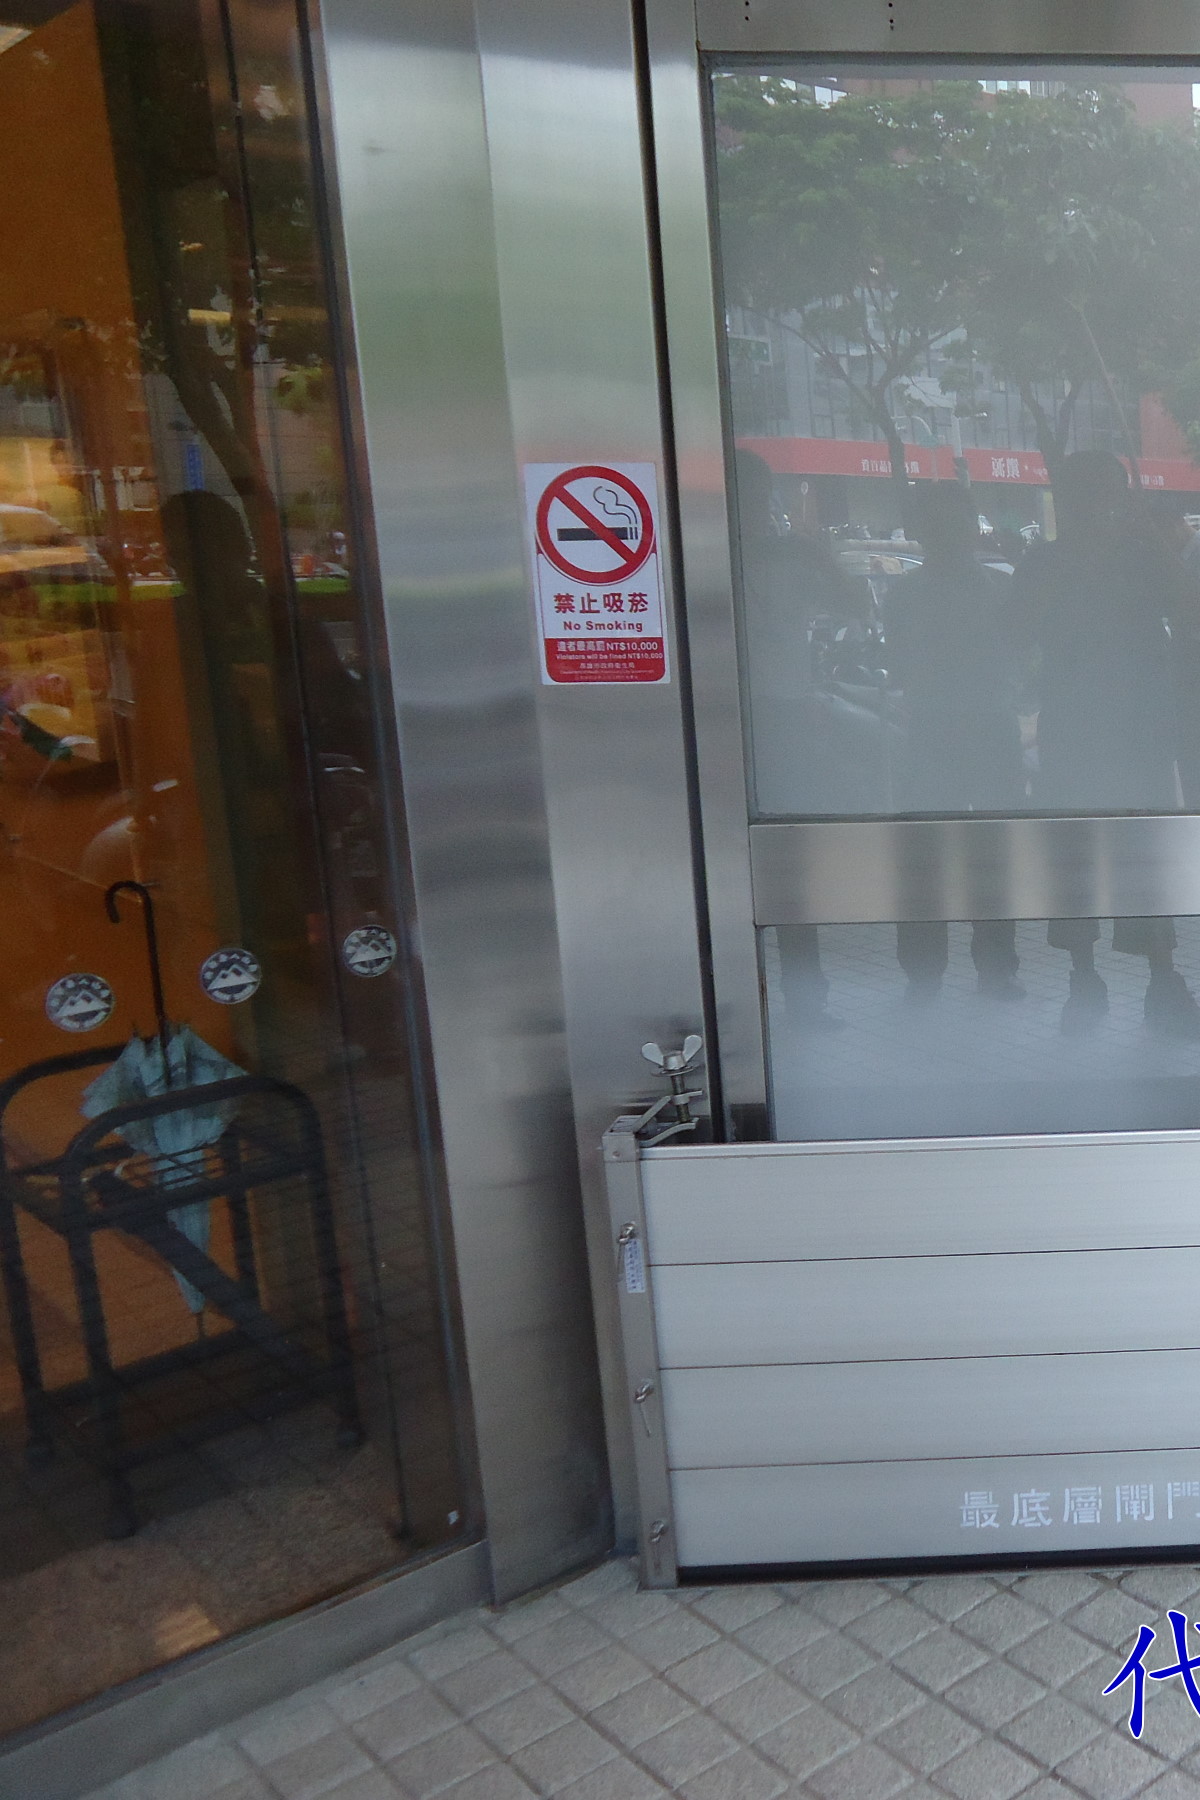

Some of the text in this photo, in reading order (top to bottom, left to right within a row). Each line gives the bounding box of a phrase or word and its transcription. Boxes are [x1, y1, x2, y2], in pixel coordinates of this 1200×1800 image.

[553, 592, 648, 614] 禁止吸菸
[563, 620, 643, 633] No Smoking
